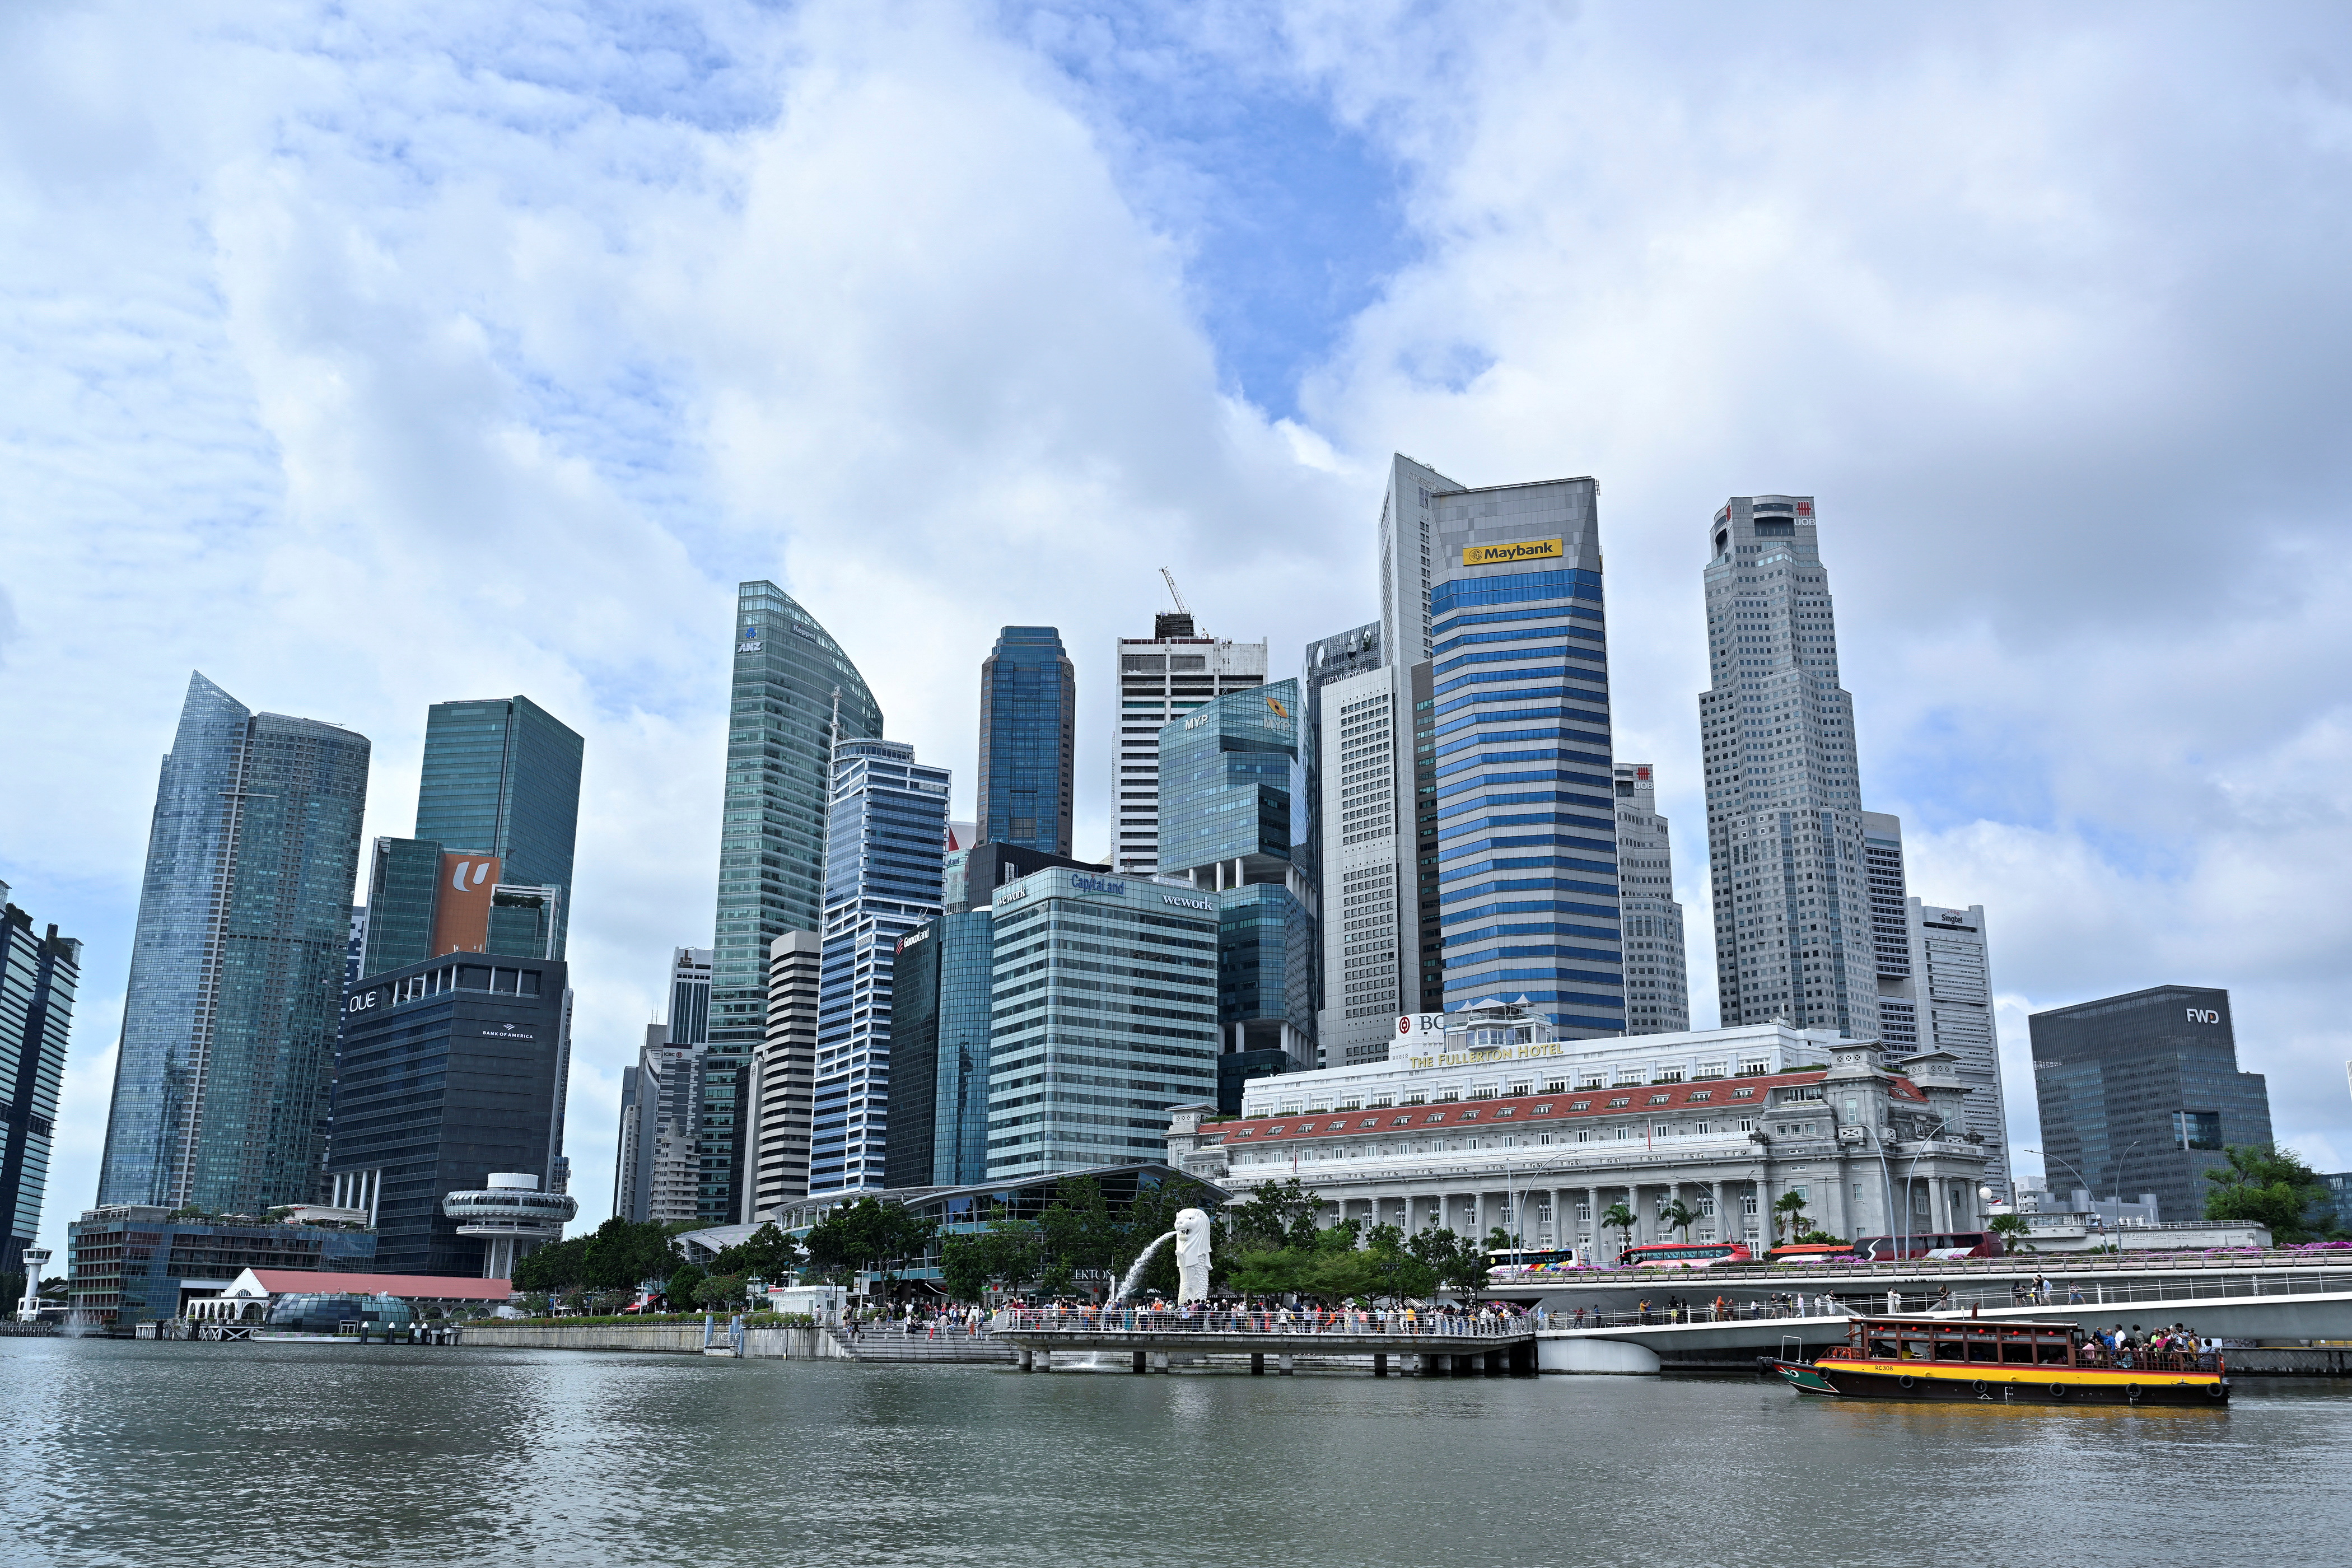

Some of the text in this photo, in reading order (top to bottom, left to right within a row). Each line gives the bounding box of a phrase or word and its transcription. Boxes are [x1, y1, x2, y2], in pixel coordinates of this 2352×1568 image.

[1794, 518, 1816, 526] UOB
[1484, 542, 1553, 559] Maybank
[794, 624, 816, 640] Keppel
[738, 642, 762, 652] ANZ
[1185, 714, 1208, 731] MYP
[1263, 718, 1290, 731] MYP
[1072, 873, 1124, 895] CapitaLand
[996, 883, 1026, 907] wework
[1162, 895, 1214, 911] wework
[1941, 913, 1963, 924] Singtel
[349, 991, 376, 1012] OUE
[2186, 1008, 2219, 1024] FWD
[1410, 1043, 1564, 1069] THE FULLERTON HOTEL
